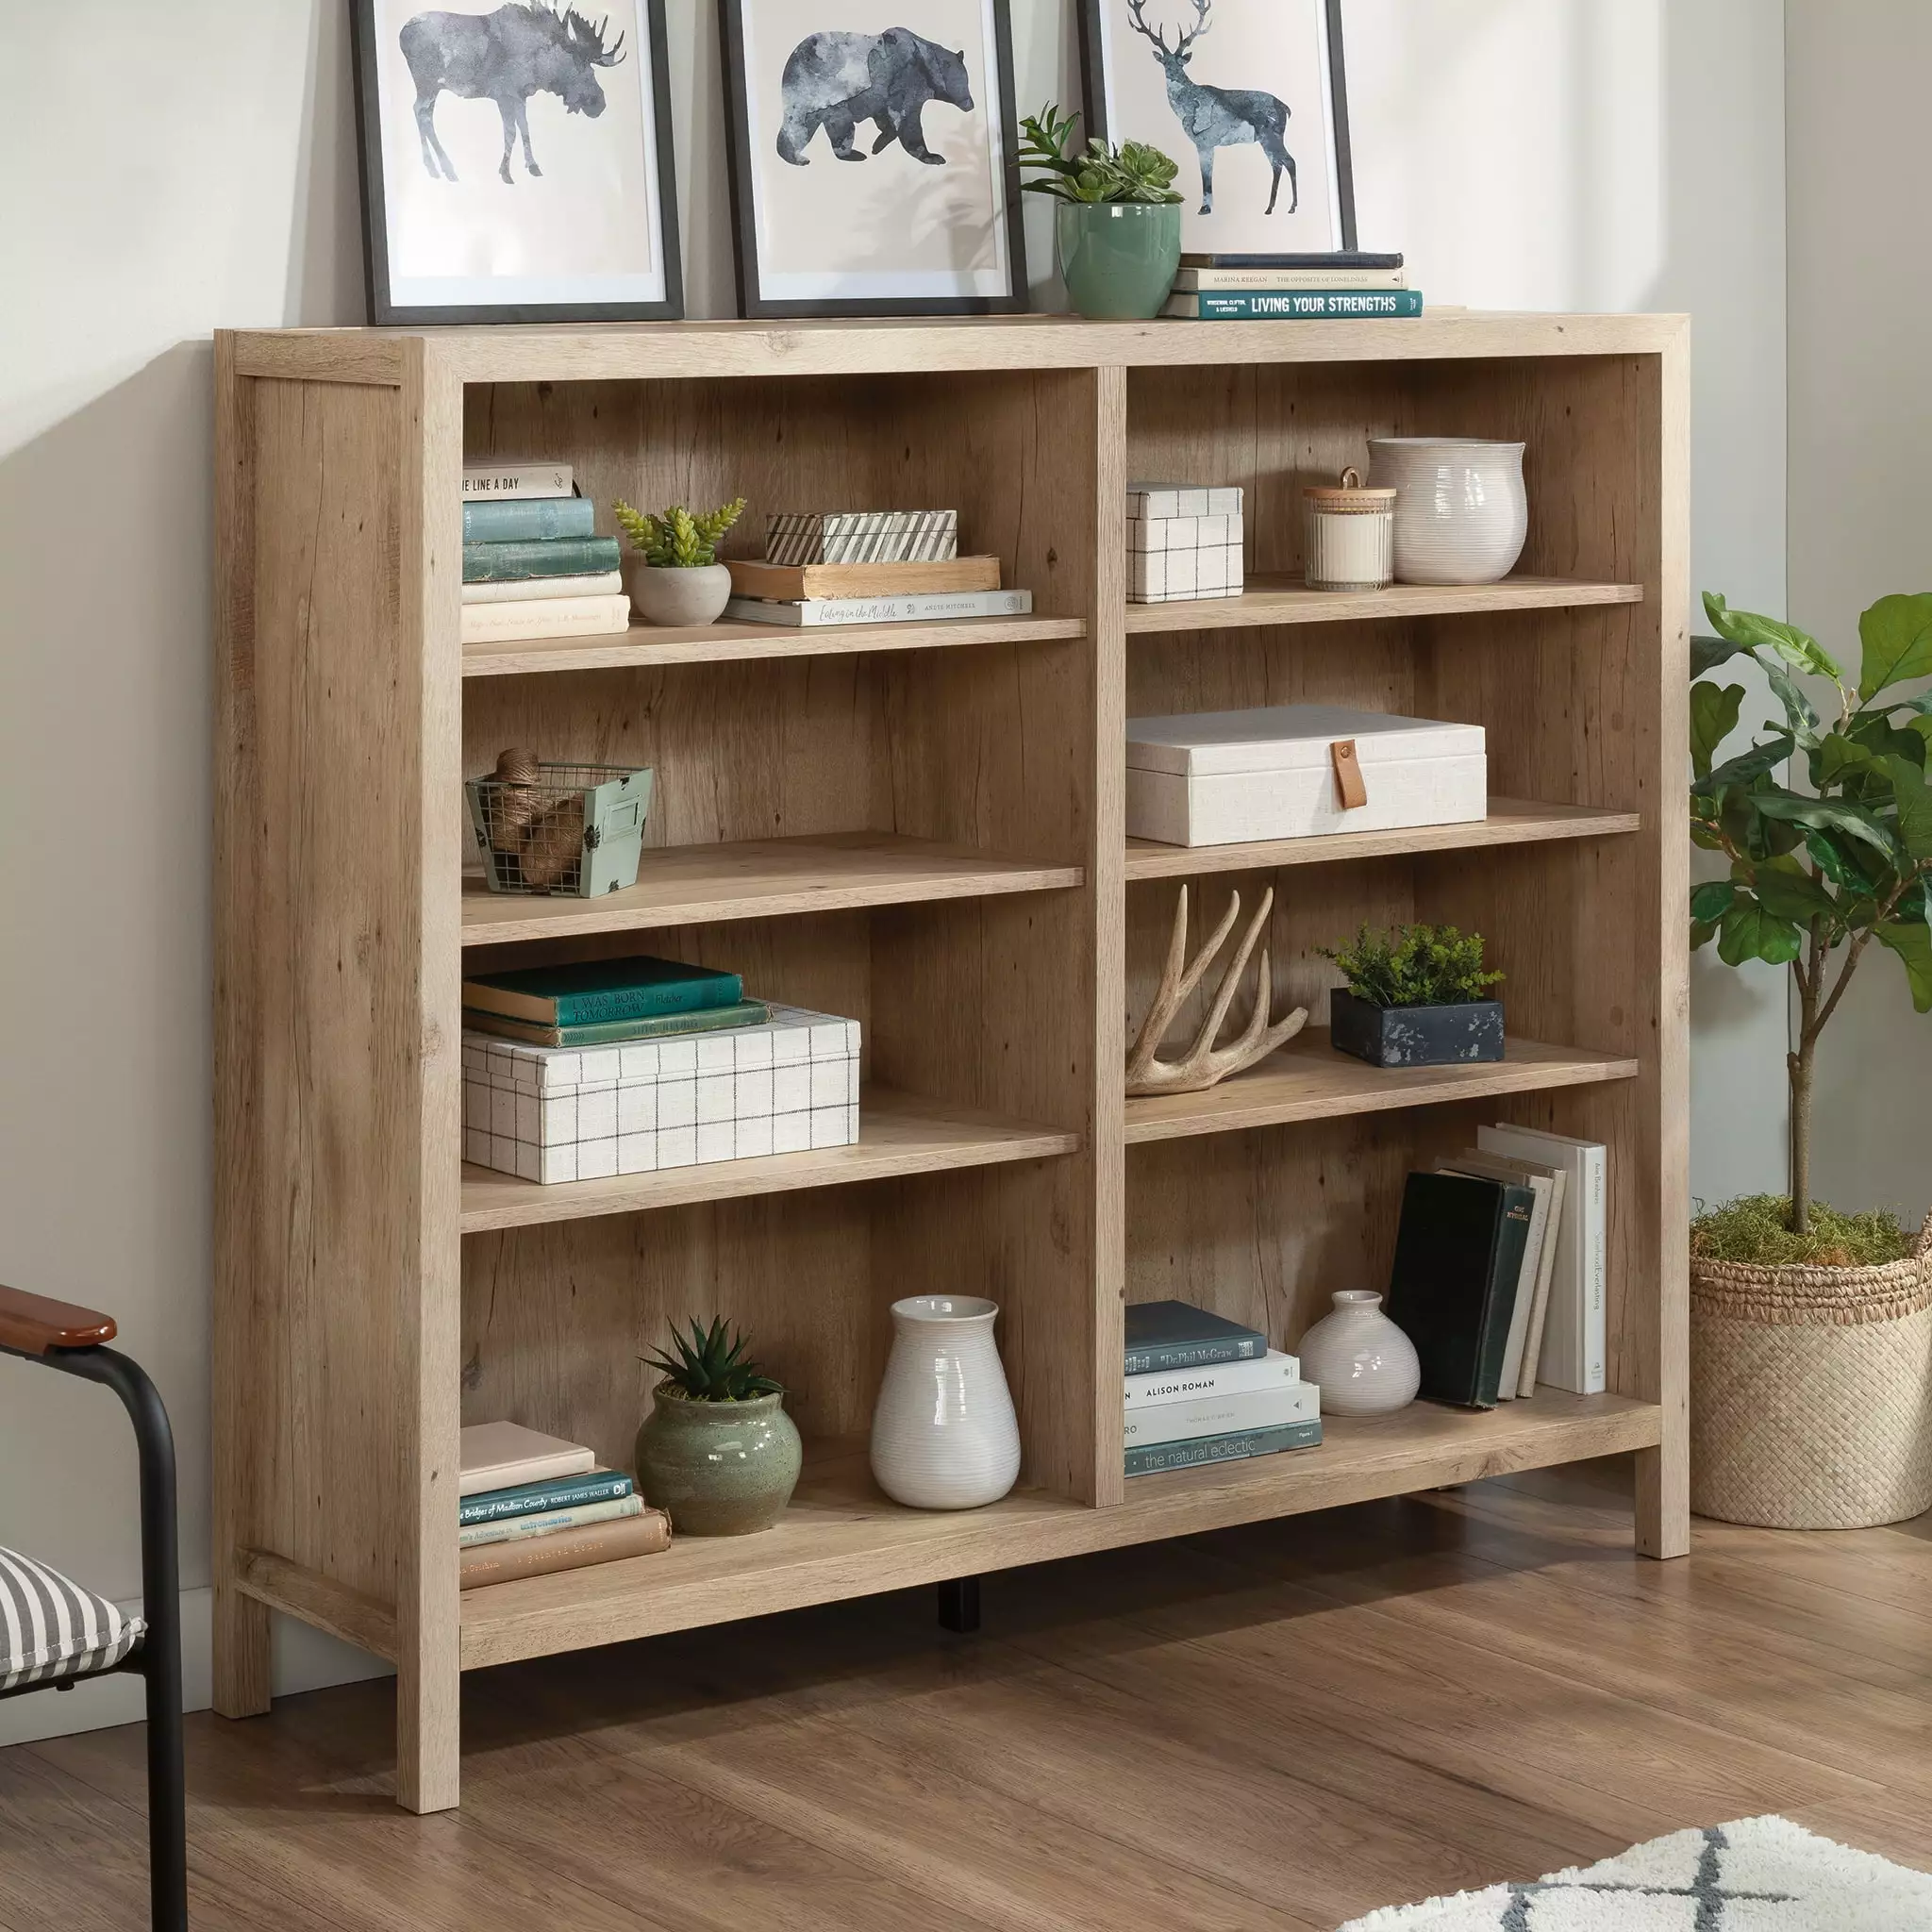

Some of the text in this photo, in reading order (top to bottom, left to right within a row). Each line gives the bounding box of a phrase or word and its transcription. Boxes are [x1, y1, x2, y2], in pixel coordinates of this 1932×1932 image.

[1251, 297, 1290, 312] LIVING
[1292, 297, 1324, 312] YOUR
[1328, 296, 1396, 311] STRENGTHS
[473, 478, 491, 491] LINE
[493, 478, 499, 490] A
[503, 477, 519, 490] DAY
[820, 604, 845, 622] Eating
[868, 603, 897, 618] Middle
[580, 995, 608, 1008] WAS
[614, 990, 644, 1004] BORN
[656, 993, 683, 1005] Fletcher
[574, 1003, 644, 1022] TOMORROW
[1197, 1348, 1233, 1360] McGraw
[1146, 1385, 1179, 1397] ALISON
[1182, 1379, 1215, 1391] ROMAN
[1145, 1438, 1256, 1469] the natural eclectic
[550, 1488, 609, 1504] ROBERT JAMES WALLER
[465, 1507, 488, 1520] Bridges
[488, 1504, 495, 1517] of
[496, 1501, 523, 1513] Madison
[524, 1497, 548, 1509] County
